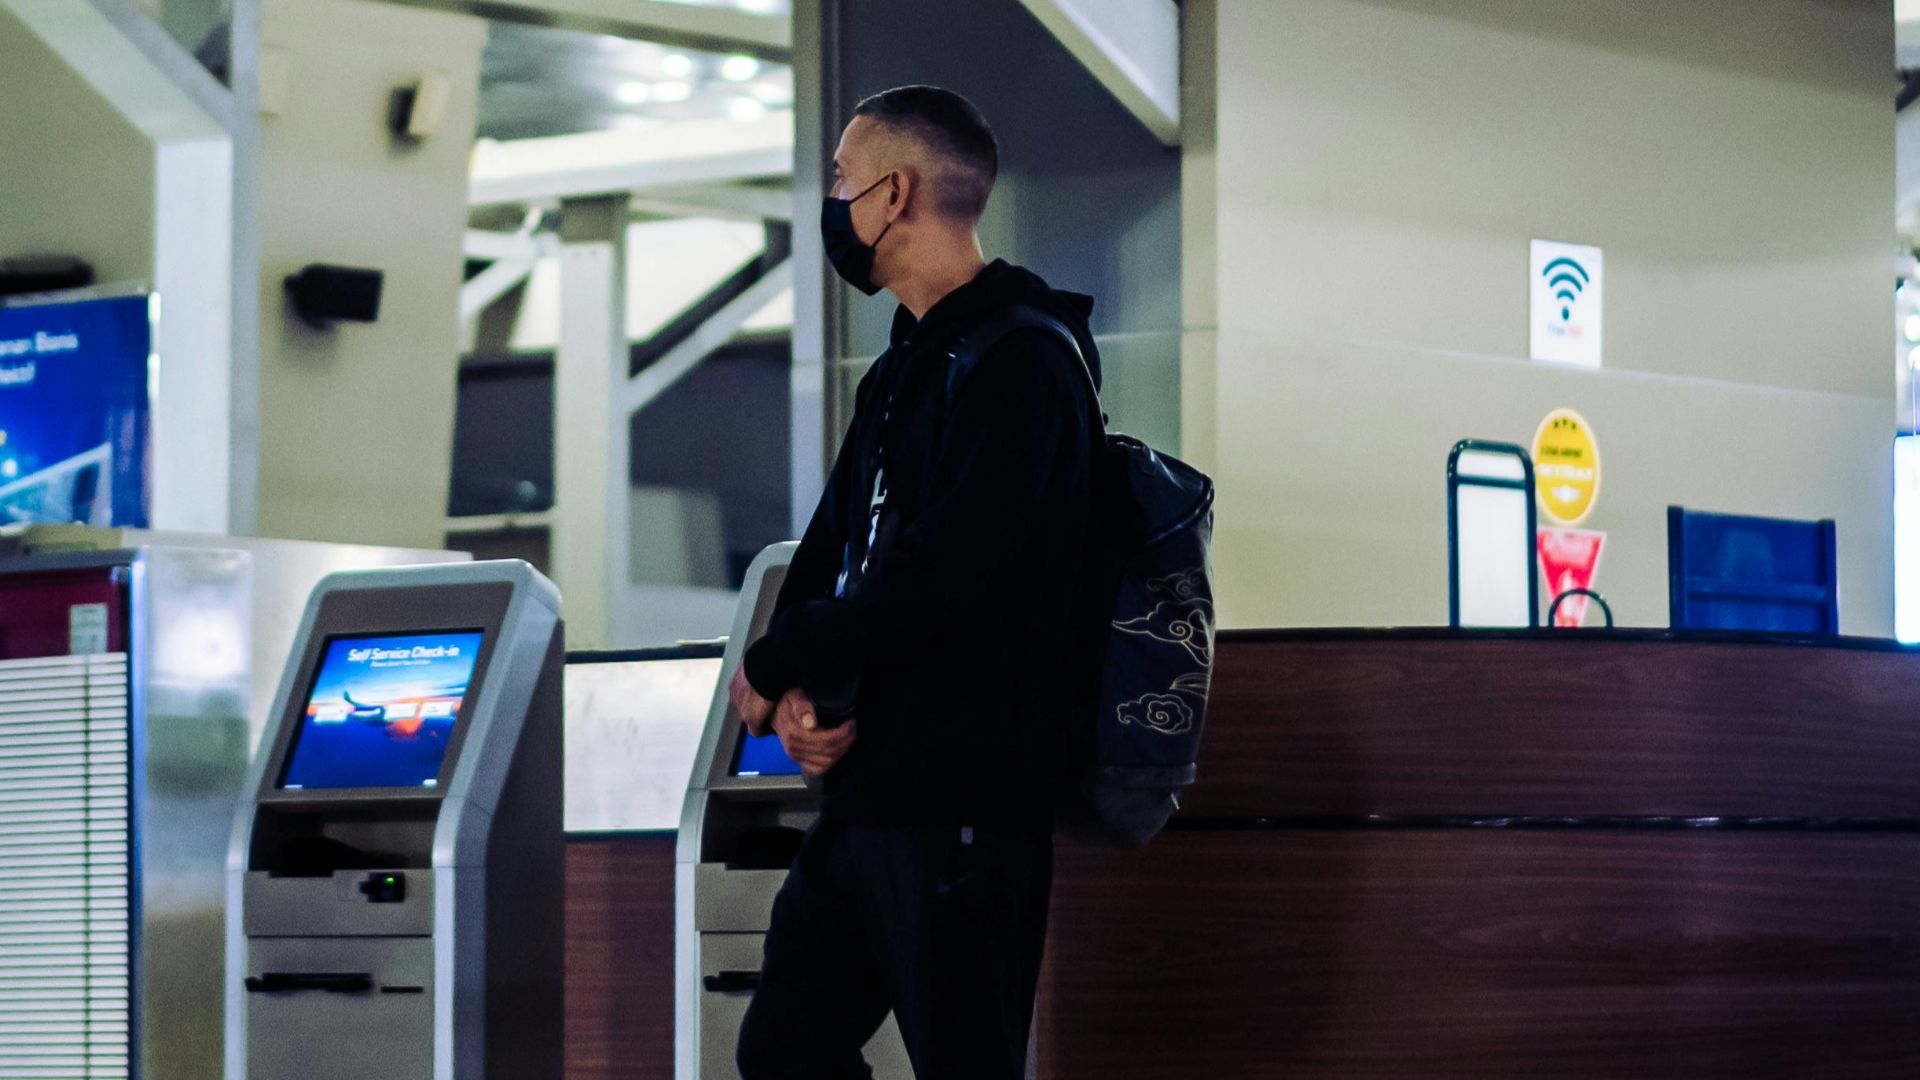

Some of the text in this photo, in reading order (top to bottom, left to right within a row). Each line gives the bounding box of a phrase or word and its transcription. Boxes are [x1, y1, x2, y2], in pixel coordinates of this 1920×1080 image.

[348, 645, 459, 663] Self Service Check-in
